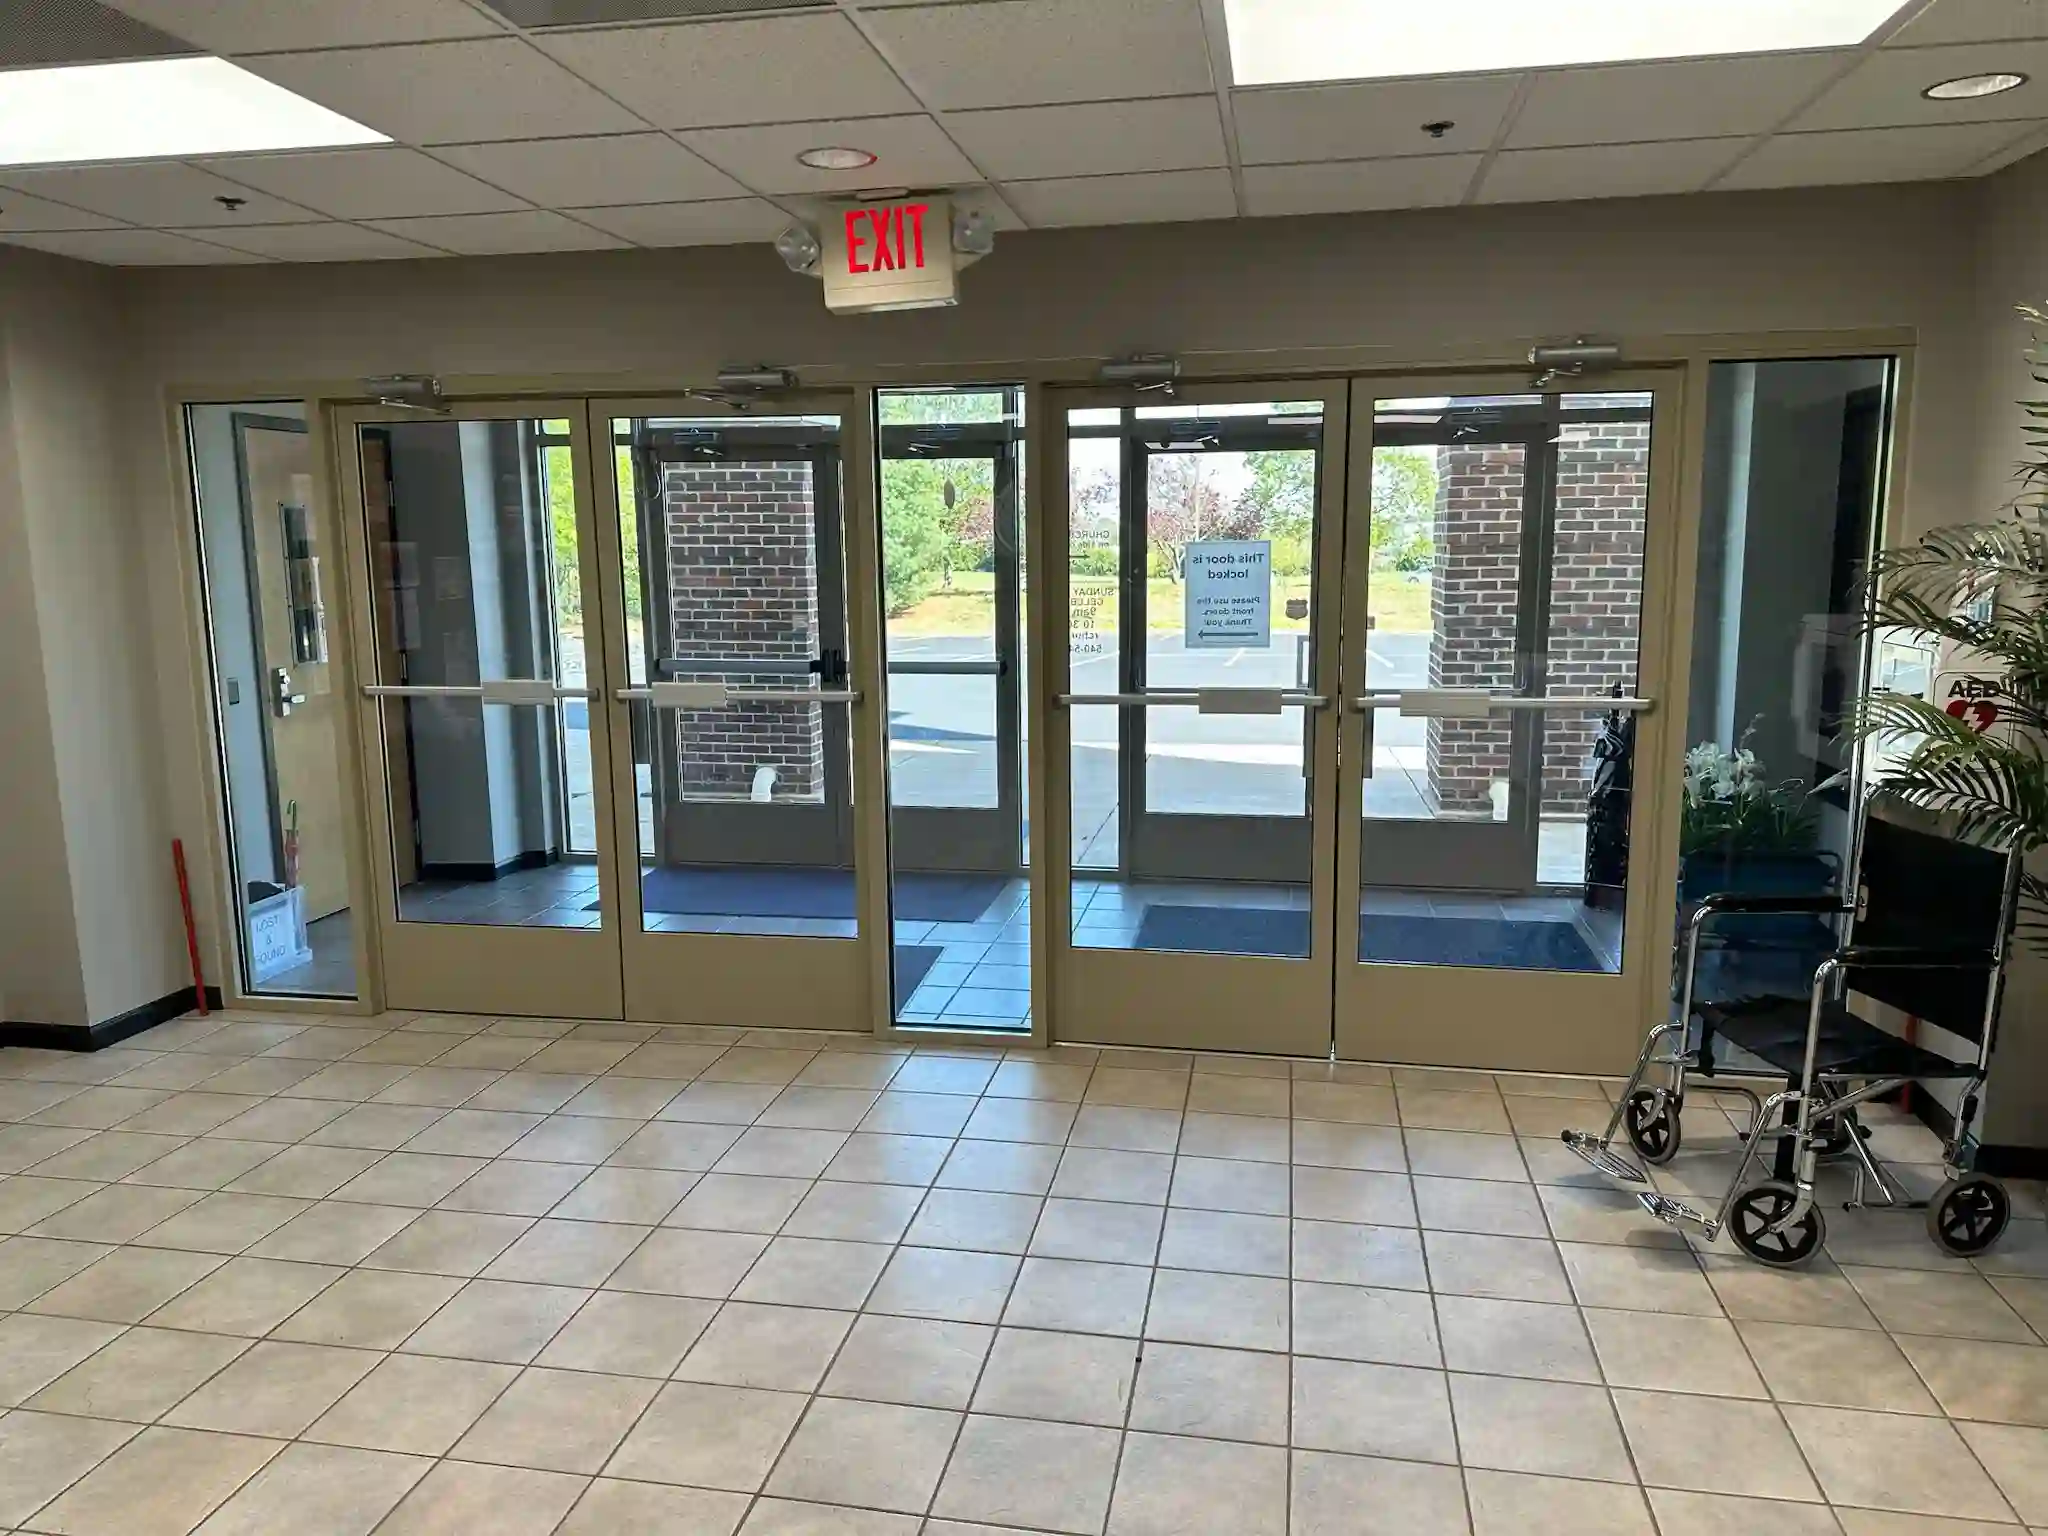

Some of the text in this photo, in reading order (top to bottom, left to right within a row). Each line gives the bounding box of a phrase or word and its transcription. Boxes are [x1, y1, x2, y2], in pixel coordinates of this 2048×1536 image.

[844, 204, 929, 274] EXIT
[1948, 680, 2001, 698] AED
[256, 915, 279, 933] LOST
